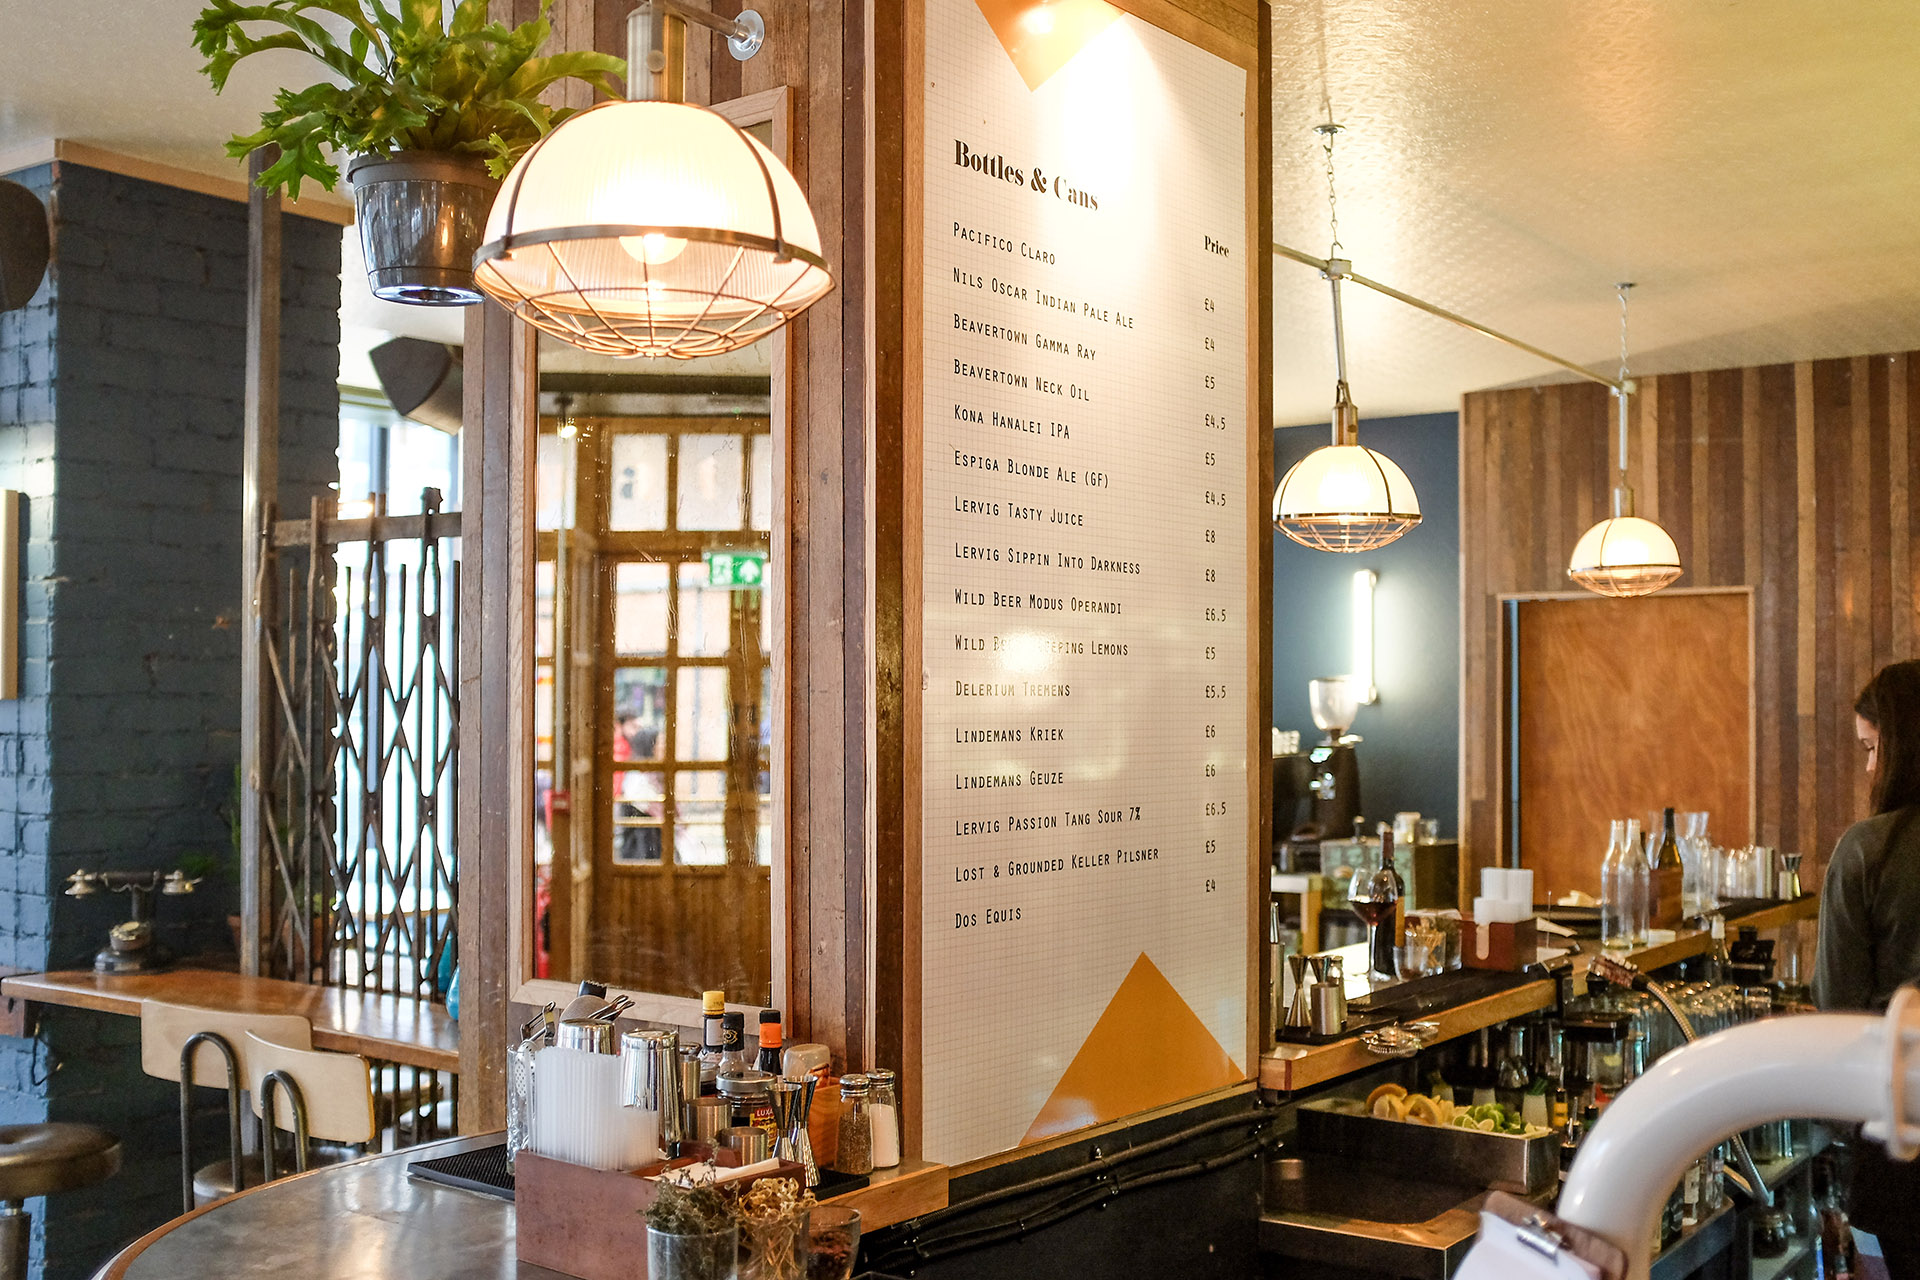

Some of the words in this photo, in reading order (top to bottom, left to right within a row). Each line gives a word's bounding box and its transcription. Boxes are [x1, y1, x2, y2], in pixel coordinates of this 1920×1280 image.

[954, 139, 1024, 186] Bottles
[1031, 168, 1047, 193] &
[1054, 176, 1098, 210] Cans
[954, 222, 1012, 253] PACIFICO
[1021, 242, 1056, 265] CLARO
[1205, 236, 1229, 257] Price
[954, 267, 983, 289] NILS
[992, 278, 1027, 301] OSCAR
[1036, 290, 1076, 313] INDIAN
[1084, 303, 1108, 322] PALE
[1116, 312, 1133, 329] ALE
[1204, 298, 1214, 312] £4
[954, 313, 1027, 345] BEAVERTOWN
[1036, 334, 1069, 355] GAMMA
[1078, 344, 1096, 360] RAY
[1205, 337, 1214, 351] £4
[954, 359, 1027, 388] BEAVERTOWN
[1036, 377, 1062, 395] NECK
[1070, 384, 1089, 401] OIL
[1205, 375, 1215, 389] £5
[954, 405, 983, 424] KONA
[992, 412, 1040, 434] HANALEI
[1051, 422, 1069, 439] IPA
[1205, 414, 1225, 430] £4.5
[1205, 452, 1215, 466] £5
[955, 450, 999, 471] ESPIGA
[1008, 459, 1048, 479] BLONDE
[1057, 467, 1076, 483] ALE
[1085, 471, 1108, 488] (GF)
[1205, 491, 1226, 506] £4.5
[955, 496, 999, 516] LERVIG
[1008, 503, 1042, 520] TASTY
[1050, 509, 1083, 526] JUICE
[1205, 530, 1215, 543] £8
[956, 543, 999, 561] LERVIG
[1008, 548, 1049, 566] SIPPIN
[1058, 553, 1083, 569] INTO
[1091, 556, 1140, 574] DARKNESS
[1206, 569, 1215, 582] £8
[955, 589, 984, 605] WILD
[994, 591, 1021, 608] BEER
[1030, 594, 1063, 610] MODUS
[1071, 597, 1122, 614] OPERANDI
[1206, 608, 1226, 622] £6.5
[955, 635, 984, 650] WILD
[1092, 641, 1128, 656] LEMONS
[1206, 647, 1215, 660] £5
[956, 680, 1014, 696] DELERIUM
[1024, 682, 1070, 697] TREMENS
[1205, 686, 1226, 698] £5.5
[956, 728, 1021, 743] LINDEMANS
[1030, 727, 1064, 741] KRIEK
[1205, 725, 1215, 738] £6
[1206, 764, 1215, 777] £6
[956, 774, 1021, 790] LINDEMANS
[1030, 771, 1063, 786] GEUZE
[1206, 802, 1226, 816] £6.5
[956, 820, 999, 836] LERVIG
[1009, 816, 1056, 831] PASSION
[1065, 812, 1090, 826] TANG
[1098, 810, 1122, 824] SOUR
[1130, 807, 1140, 821] 7%
[1206, 840, 1215, 853] £5
[956, 867, 984, 882] LOST
[994, 865, 999, 878] &
[1008, 859, 1064, 876] GROUNDED
[1072, 853, 1109, 868] KELLER
[1117, 848, 1158, 863] PILSNER
[1206, 880, 1215, 892] £4
[956, 913, 976, 929] DOS
[986, 908, 1021, 924] EQUIS
[757, 1108, 773, 1117] LUXA
